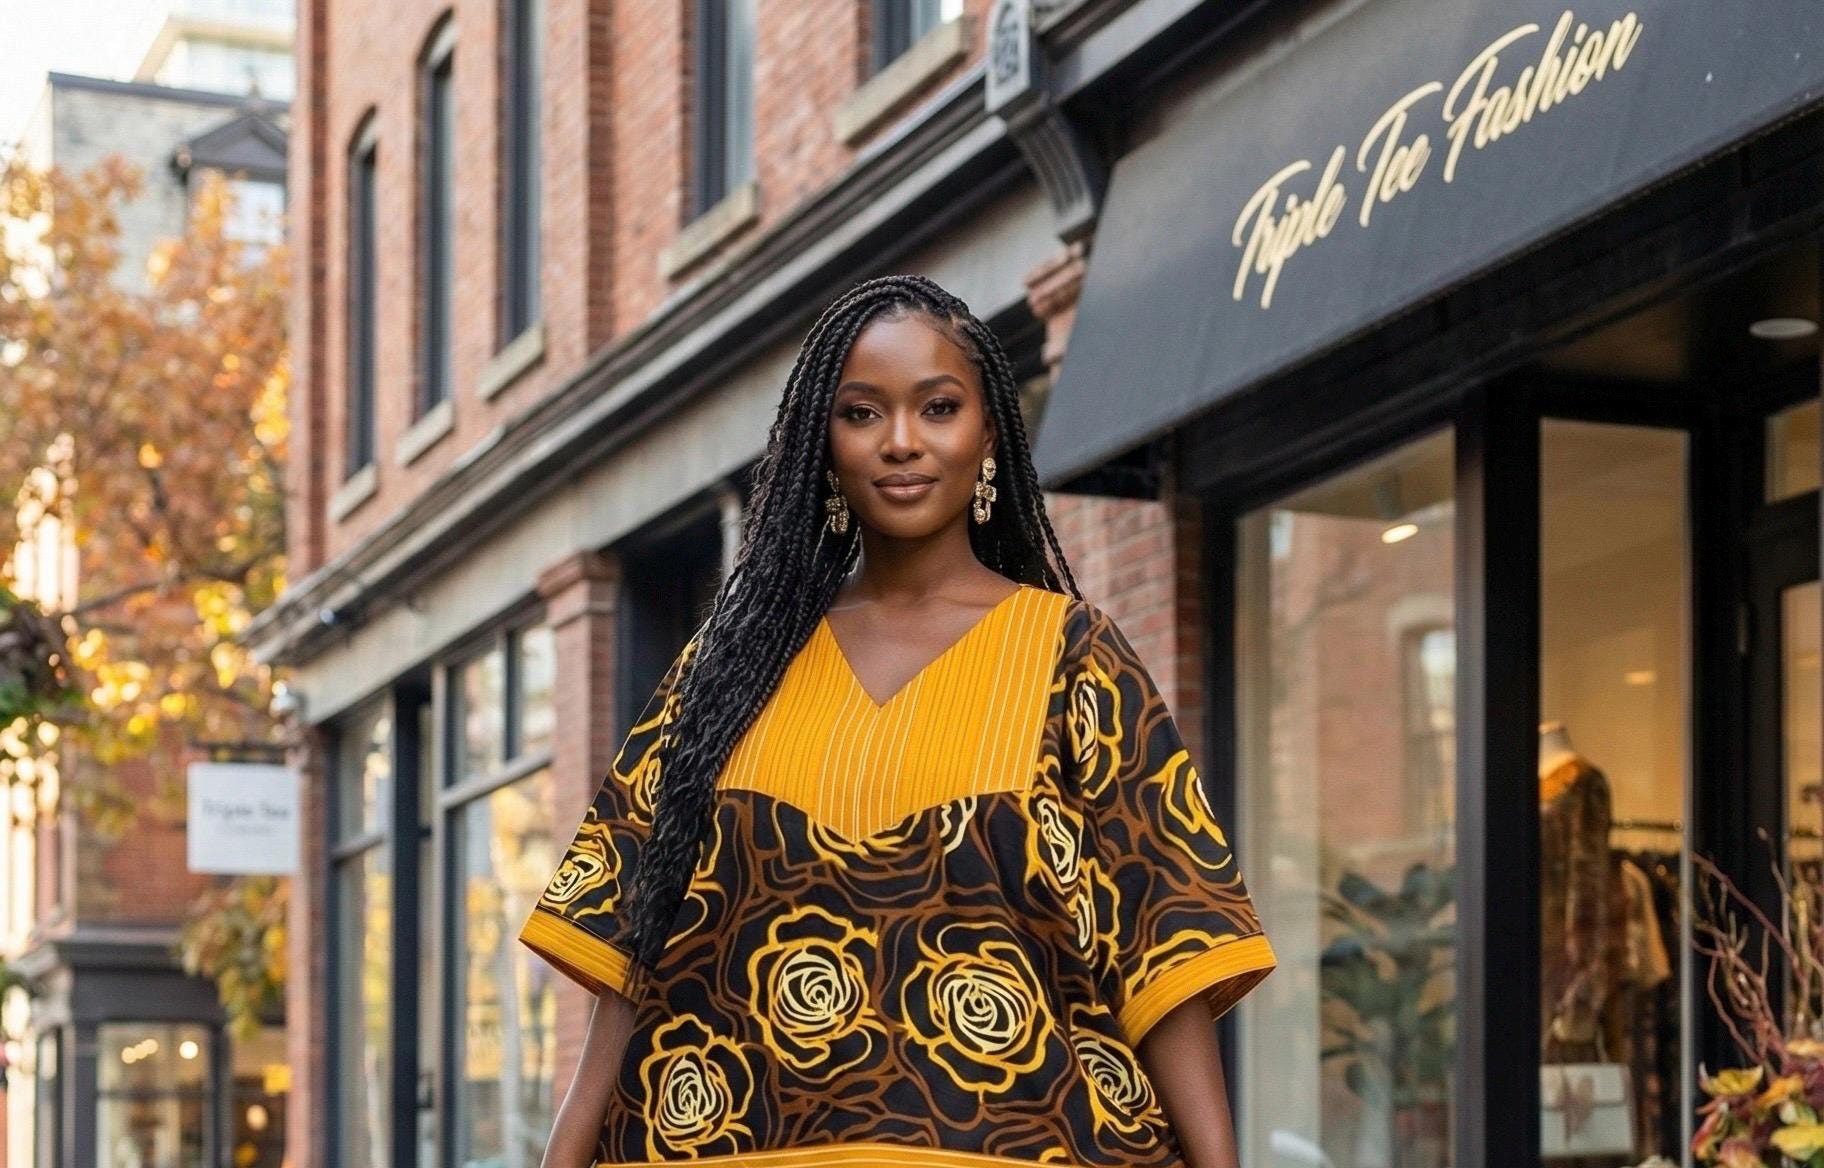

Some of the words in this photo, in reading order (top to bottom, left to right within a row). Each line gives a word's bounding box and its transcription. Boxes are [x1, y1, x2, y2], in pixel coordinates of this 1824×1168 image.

[1231, 144, 1348, 310] Triple
[1356, 80, 1443, 228] Tee
[1442, 9, 1644, 184] Fashion
